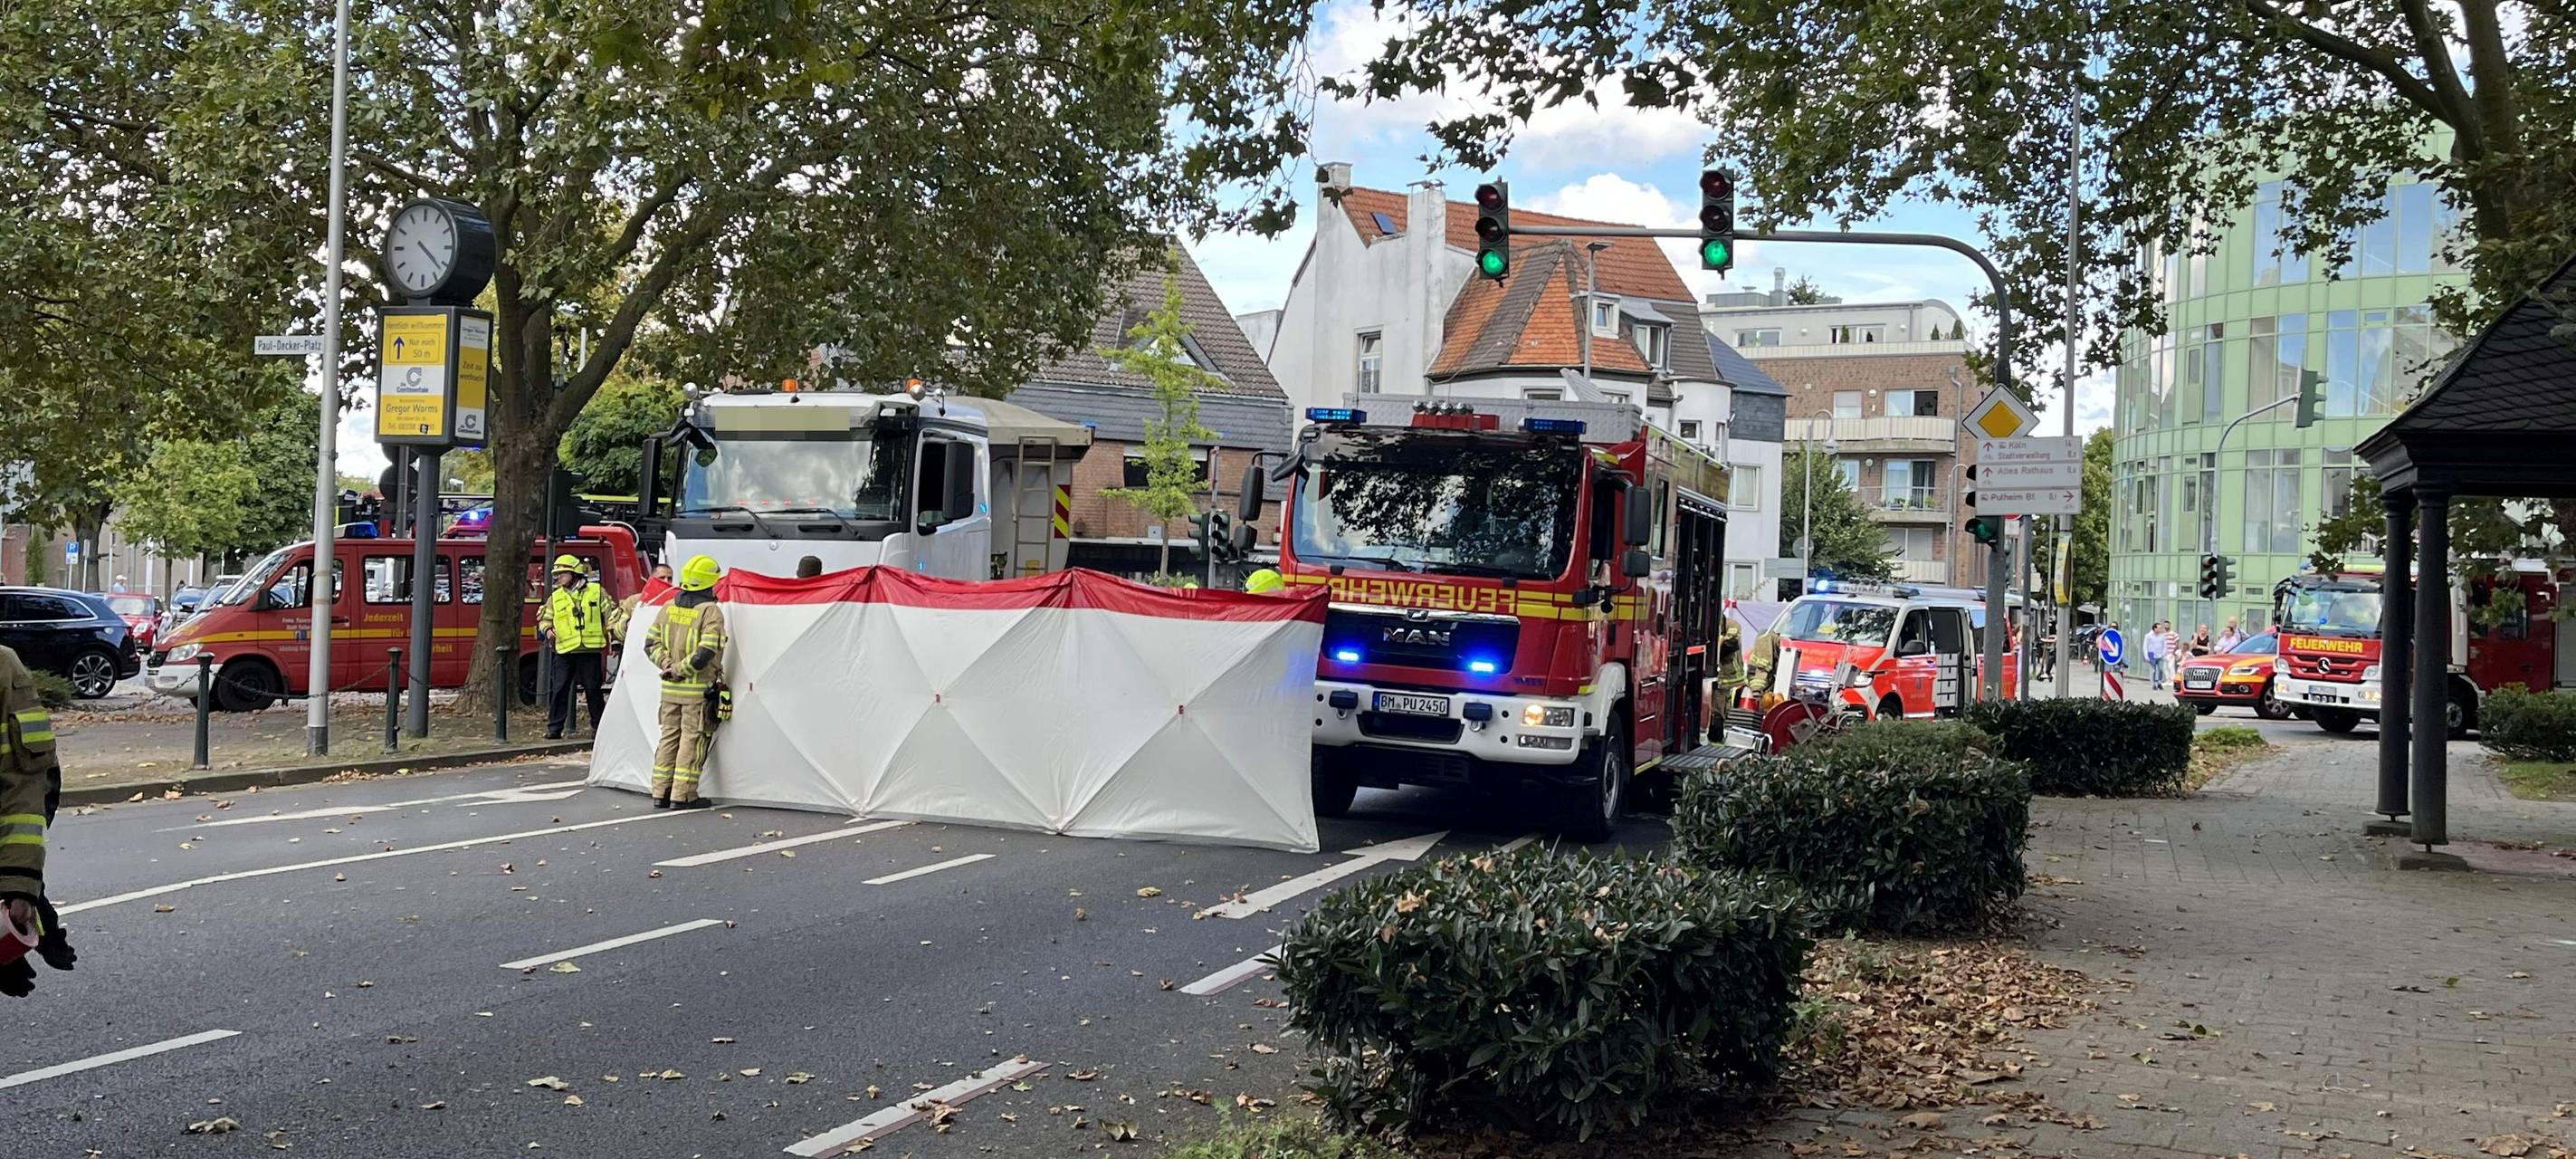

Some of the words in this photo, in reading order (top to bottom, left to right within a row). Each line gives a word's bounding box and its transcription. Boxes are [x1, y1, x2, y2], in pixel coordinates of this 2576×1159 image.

[258, 340, 321, 350] Paul-Decker-Platz
[413, 349, 423, 358] 50
[386, 403, 411, 416] Gregor
[412, 404, 438, 414] Worms
[2008, 441, 2027, 449] Köln
[1998, 452, 2050, 461] Stadtverwaltung
[2020, 466, 2054, 474] Rathaus
[1990, 493, 2024, 501] Pulheim
[363, 612, 404, 623] Jederzeit
[391, 628, 405, 637] für
[1382, 627, 1451, 647] MAN
[432, 644, 453, 653] rheit
[2289, 637, 2363, 653] FEUERWEHR
[1380, 694, 1395, 708] BM
[1402, 698, 1416, 711] PU
[1419, 699, 1446, 713] 2450
